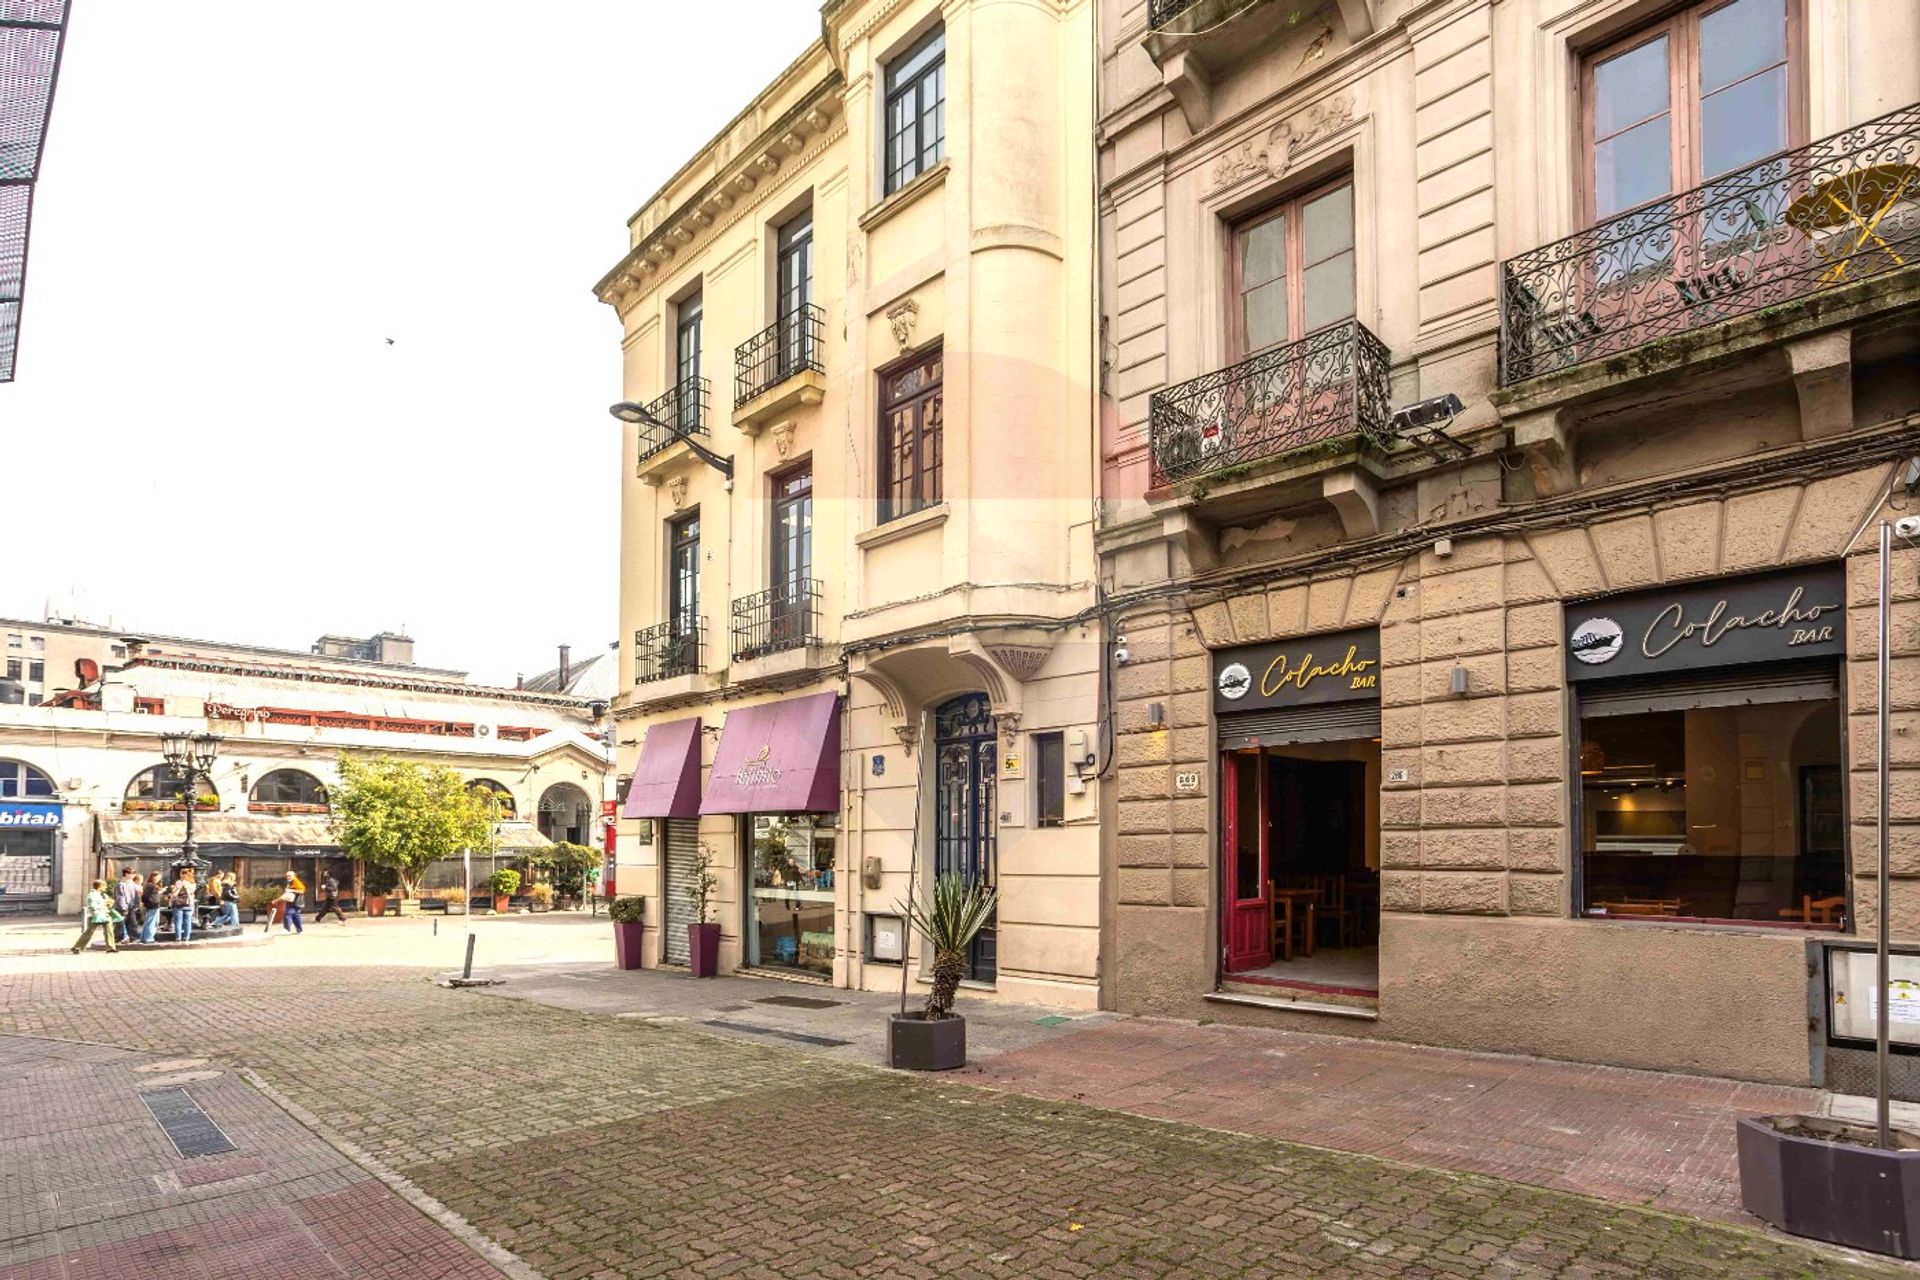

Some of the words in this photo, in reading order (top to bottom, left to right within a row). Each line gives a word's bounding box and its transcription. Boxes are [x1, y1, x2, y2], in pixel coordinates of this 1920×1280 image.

[1642, 586, 1839, 658] Colacho
[1787, 625, 1833, 647] BAR
[1261, 645, 1376, 697] Colacho
[1350, 675, 1376, 690] BAR
